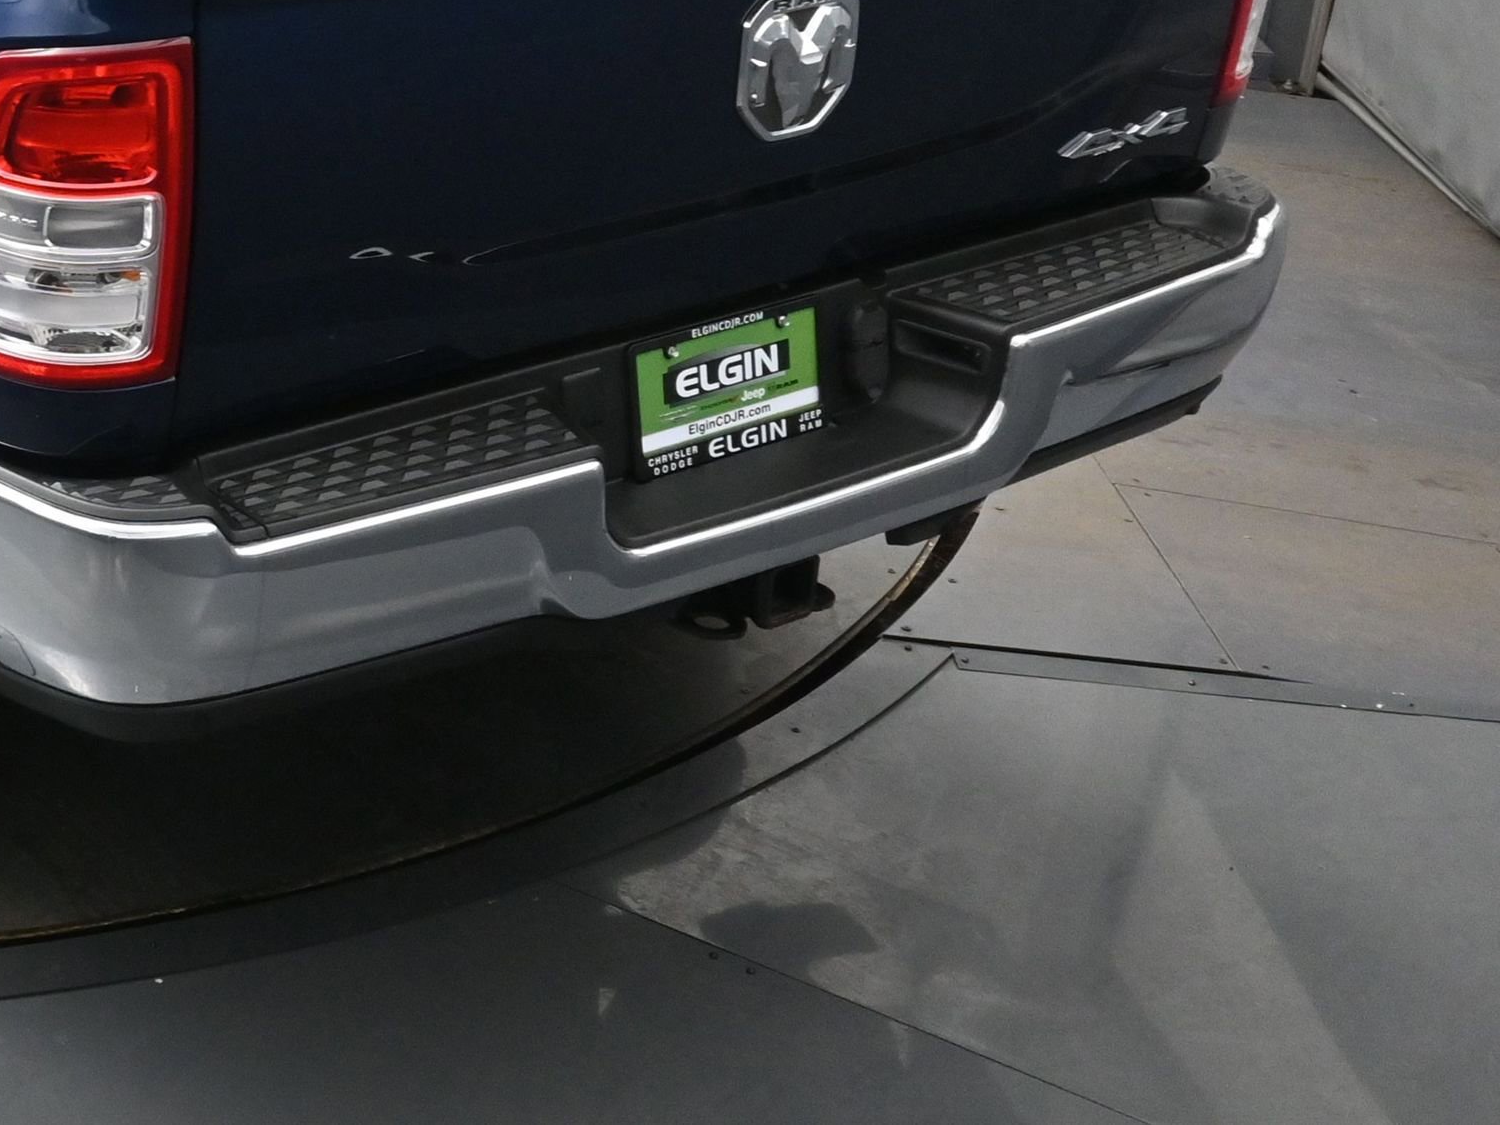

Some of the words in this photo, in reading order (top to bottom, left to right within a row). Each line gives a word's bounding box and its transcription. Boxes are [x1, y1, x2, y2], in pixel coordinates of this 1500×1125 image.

[691, 311, 764, 339] ELGINCDJR.COM
[675, 343, 780, 398] ELGIN
[740, 386, 766, 402] Jeep
[688, 403, 771, 435] ElginCDJR.com
[798, 409, 822, 423] JEEP
[800, 419, 823, 433] RAM
[708, 418, 788, 458] ELGIN
[648, 445, 699, 468] CHRYSLER
[653, 457, 693, 476] DODGE
